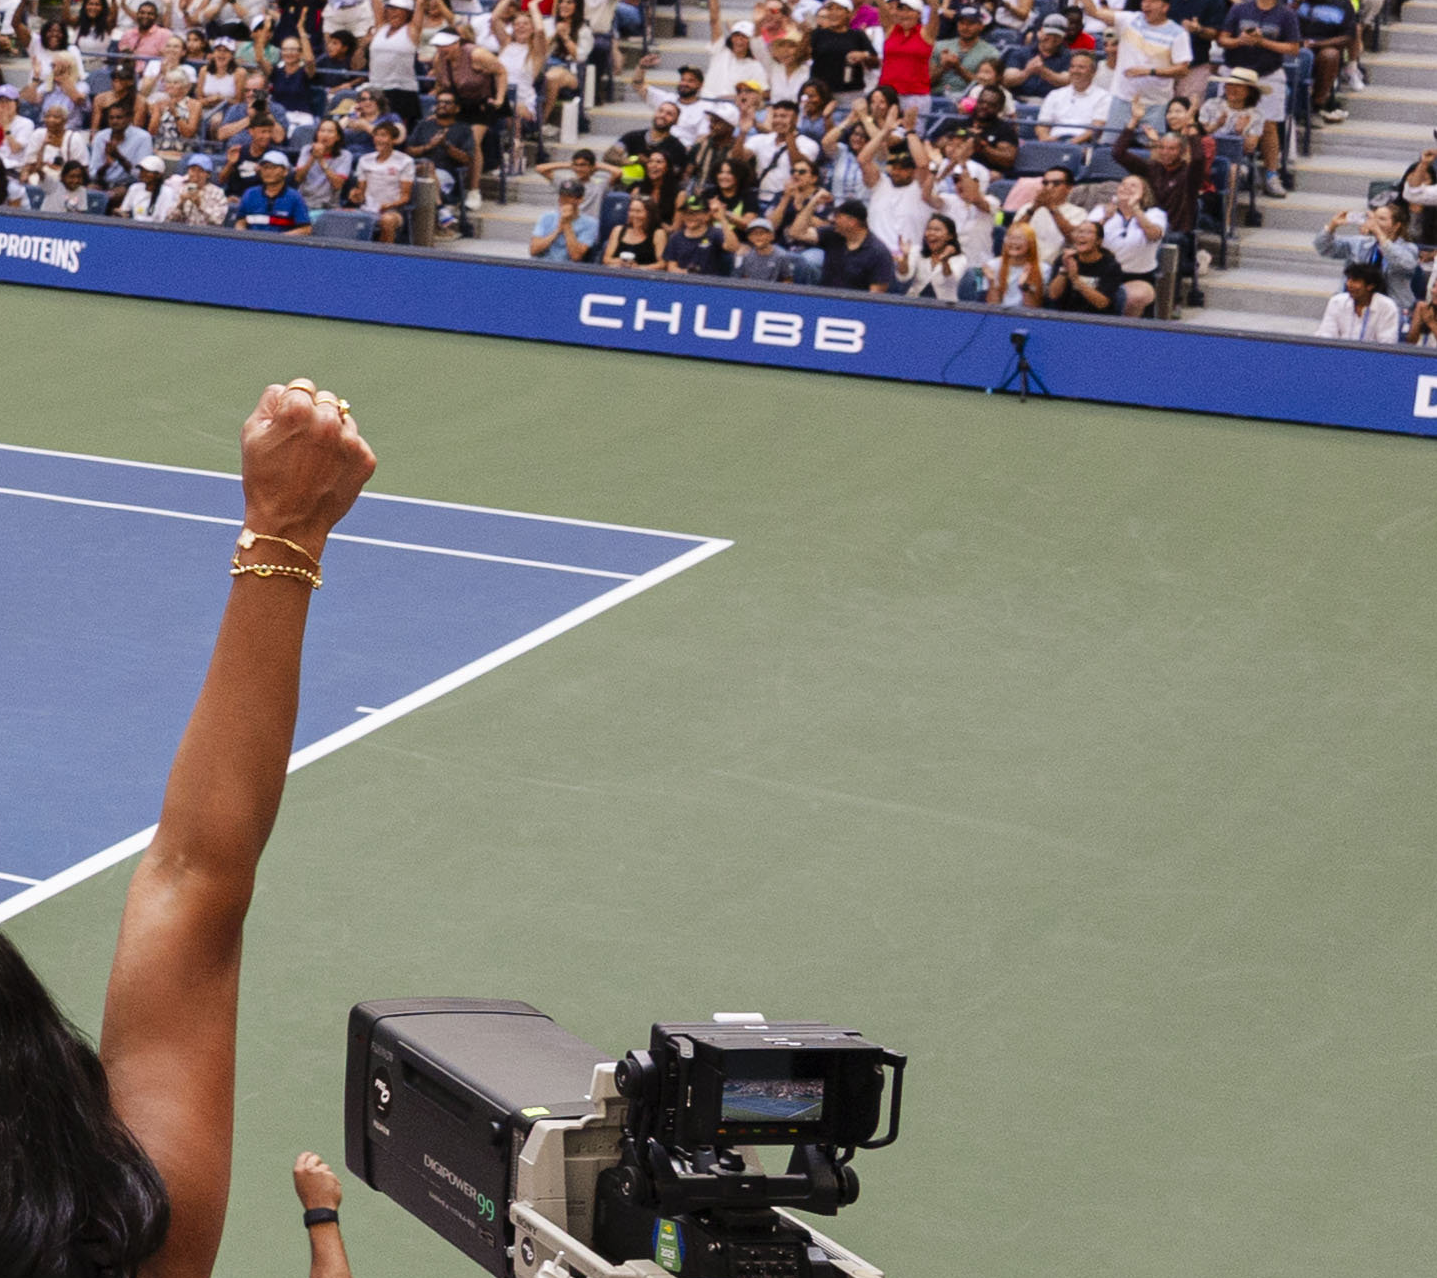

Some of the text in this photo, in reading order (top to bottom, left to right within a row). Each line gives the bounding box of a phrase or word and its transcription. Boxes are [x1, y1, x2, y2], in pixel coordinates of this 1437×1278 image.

[579, 293, 866, 353] CHUBB
[424, 1154, 478, 1201] DIGIPOWER
[476, 1193, 495, 1222] 99
